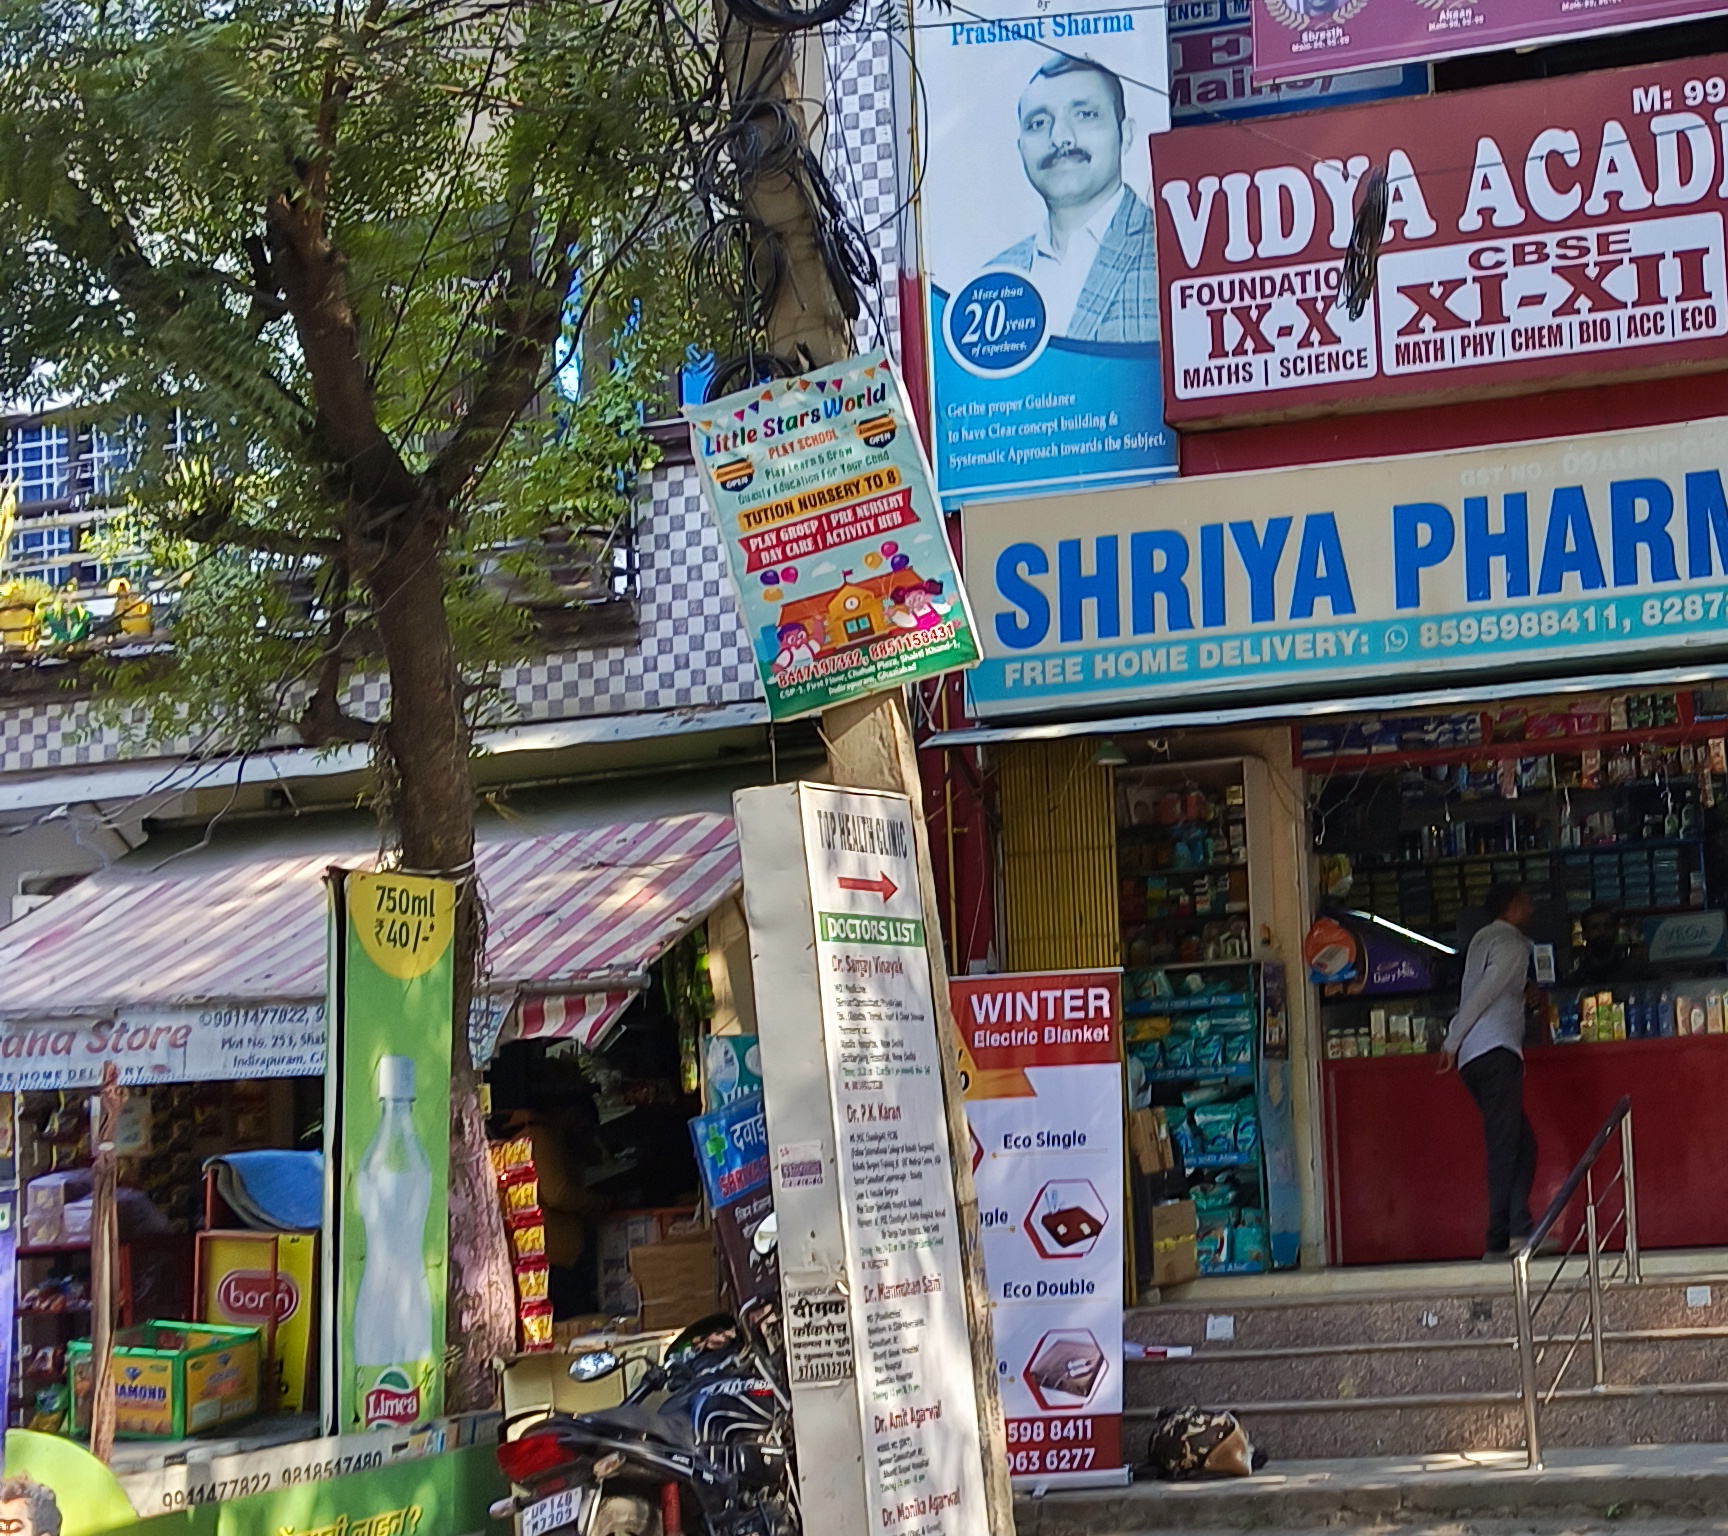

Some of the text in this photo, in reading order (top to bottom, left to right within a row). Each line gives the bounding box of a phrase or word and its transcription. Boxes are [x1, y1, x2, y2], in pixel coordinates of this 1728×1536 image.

[951, 12, 1135, 46] Prashant Sharma
[1632, 84, 1674, 114] M:
[1162, 149, 1438, 270] VIDYA
[1468, 228, 1632, 272] CBSE
[1396, 247, 1713, 338] XI-XII
[961, 299, 1005, 345] 20
[1207, 294, 1343, 360] IX-X
[1394, 304, 1719, 369] MATH PHY CHEM BIO ACC ECO
[1182, 347, 1369, 391] MATHS SCIENCE
[702, 380, 887, 458] Little Stars World
[988, 423, 1016, 438] Clear
[1060, 413, 1106, 432] building
[1007, 444, 1057, 465] Approach
[1060, 438, 1102, 456] towards
[743, 474, 884, 528] TUTION NURSERY TO
[749, 529, 777, 551] PLAY
[995, 510, 1358, 651] SHRIYA
[1004, 645, 1084, 689] FREE
[1094, 641, 1189, 681] HOME
[1198, 628, 1370, 668] DELIVERY:
[1419, 603, 1631, 651] 8595988411,
[817, 809, 908, 861] TOP HEALTH CLINIC
[375, 884, 436, 920] 750ml
[827, 916, 917, 944] DOCTORS LIST
[970, 986, 1112, 1026] WINTER
[85, 1017, 193, 1056] Store
[974, 1025, 1110, 1048] Electric Blanket
[1003, 1129, 1087, 1151] Eco Single
[1003, 1278, 1096, 1298] Eco Double
[367, 1391, 419, 1419] Limca
[1049, 1417, 1094, 1442] 8411
[1050, 1446, 1096, 1469] 6277
